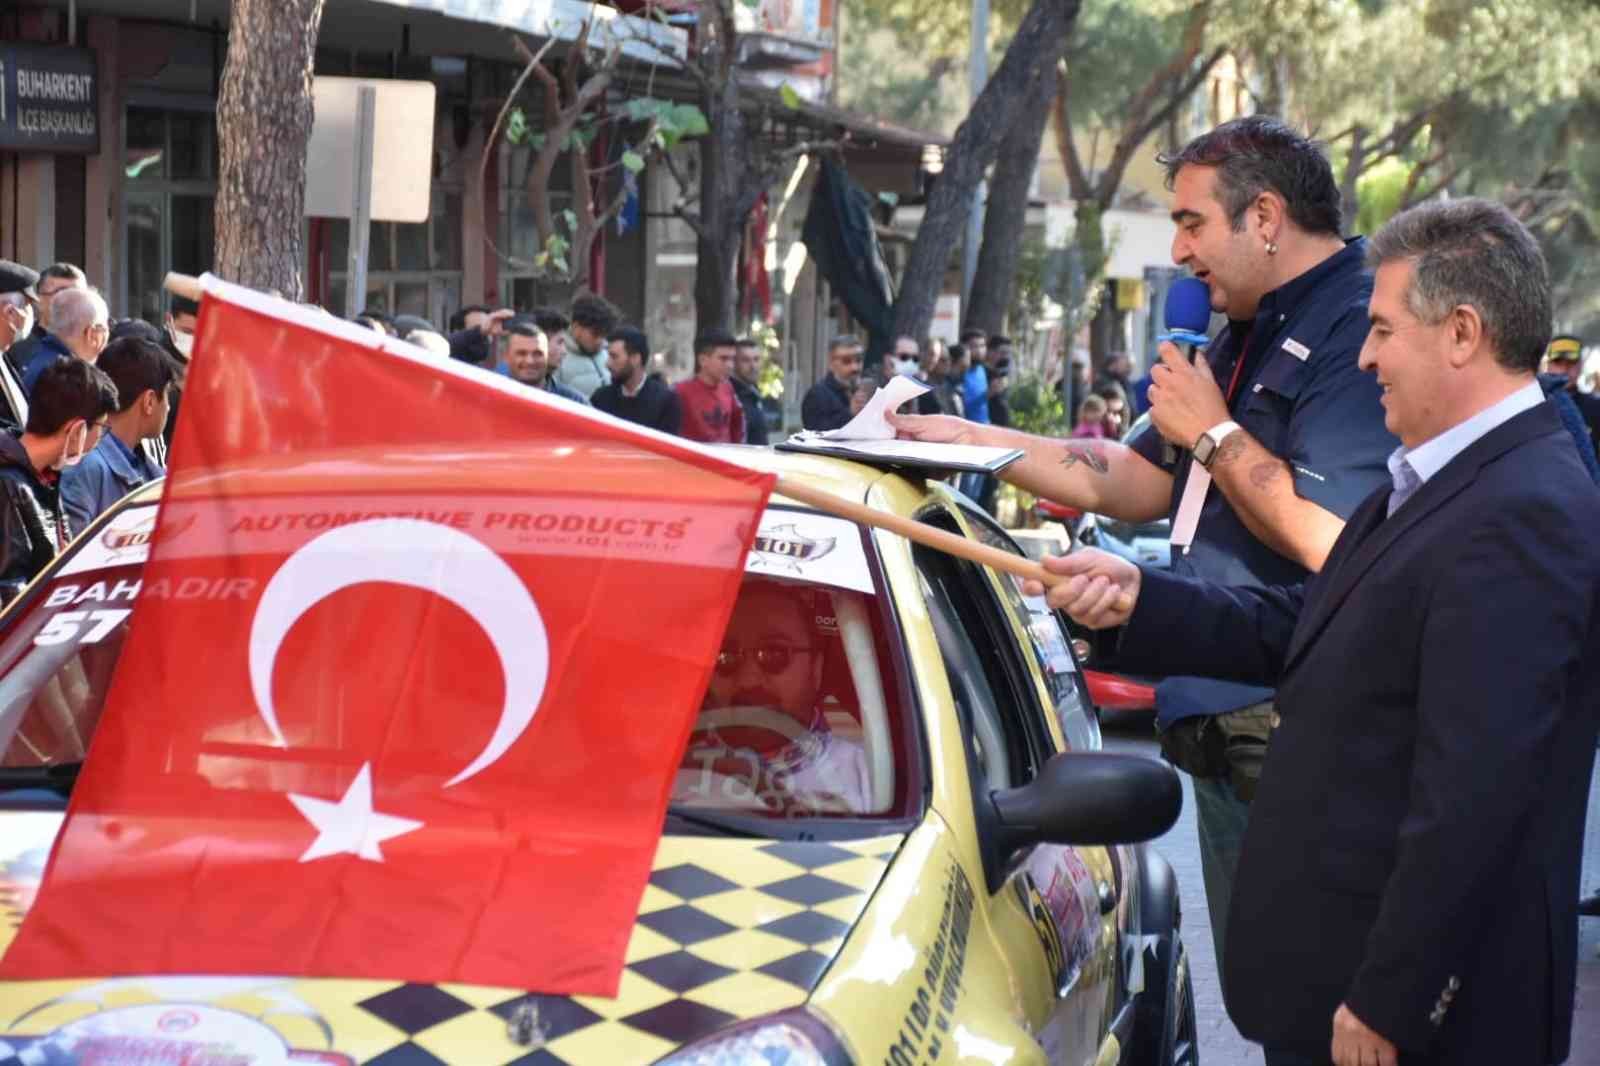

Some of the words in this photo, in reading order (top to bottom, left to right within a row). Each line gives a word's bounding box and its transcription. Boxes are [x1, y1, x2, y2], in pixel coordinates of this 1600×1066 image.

[17, 69, 91, 102] BUHARKENT
[483, 512, 687, 539] PRODUCTS
[44, 577, 257, 607] BAHADIR
[33, 608, 132, 645] 57
